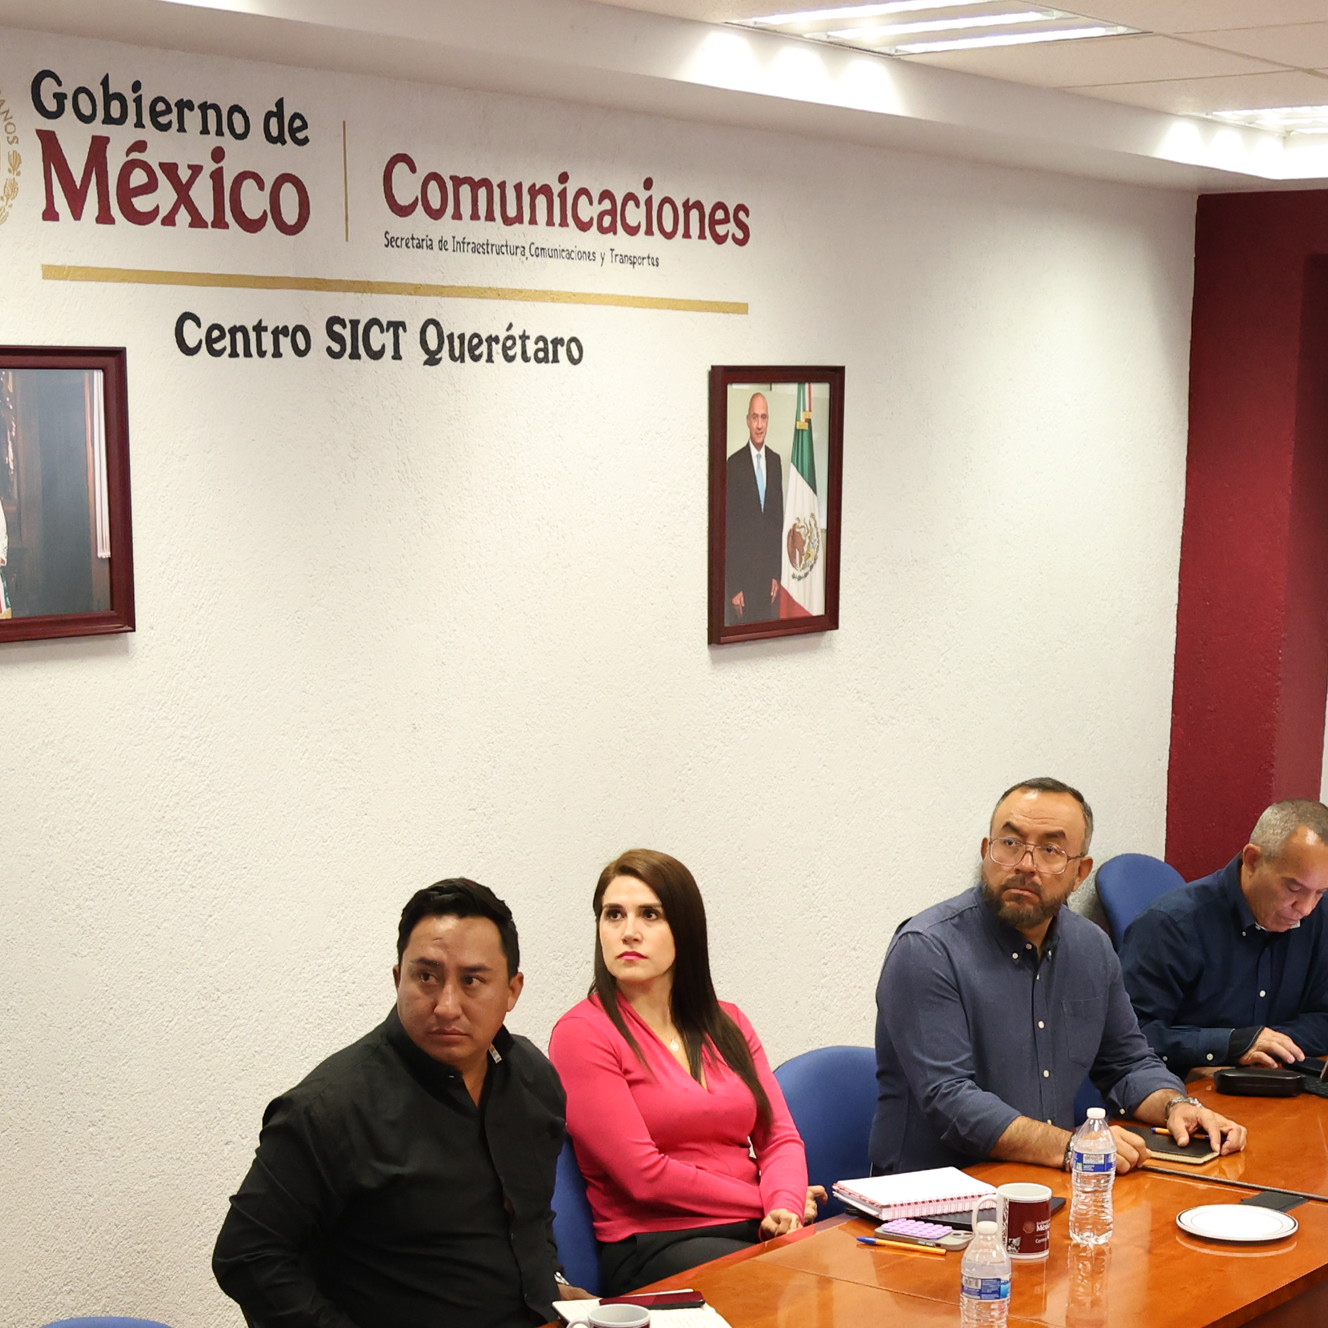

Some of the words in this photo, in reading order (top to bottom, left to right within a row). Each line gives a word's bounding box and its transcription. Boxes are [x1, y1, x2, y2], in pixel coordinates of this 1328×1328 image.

[30, 69, 251, 142] Gobierno
[263, 96, 310, 147] de
[36, 129, 311, 237] México
[382, 152, 751, 250] Comunicaciones
[437, 235, 449, 252] de
[528, 241, 597, 262] Comunicaciones
[599, 252, 606, 268] y
[609, 247, 660, 269] Transportes
[174, 311, 312, 359] Centro
[325, 315, 408, 361] SICT
[419, 317, 584, 367] Querétaro
